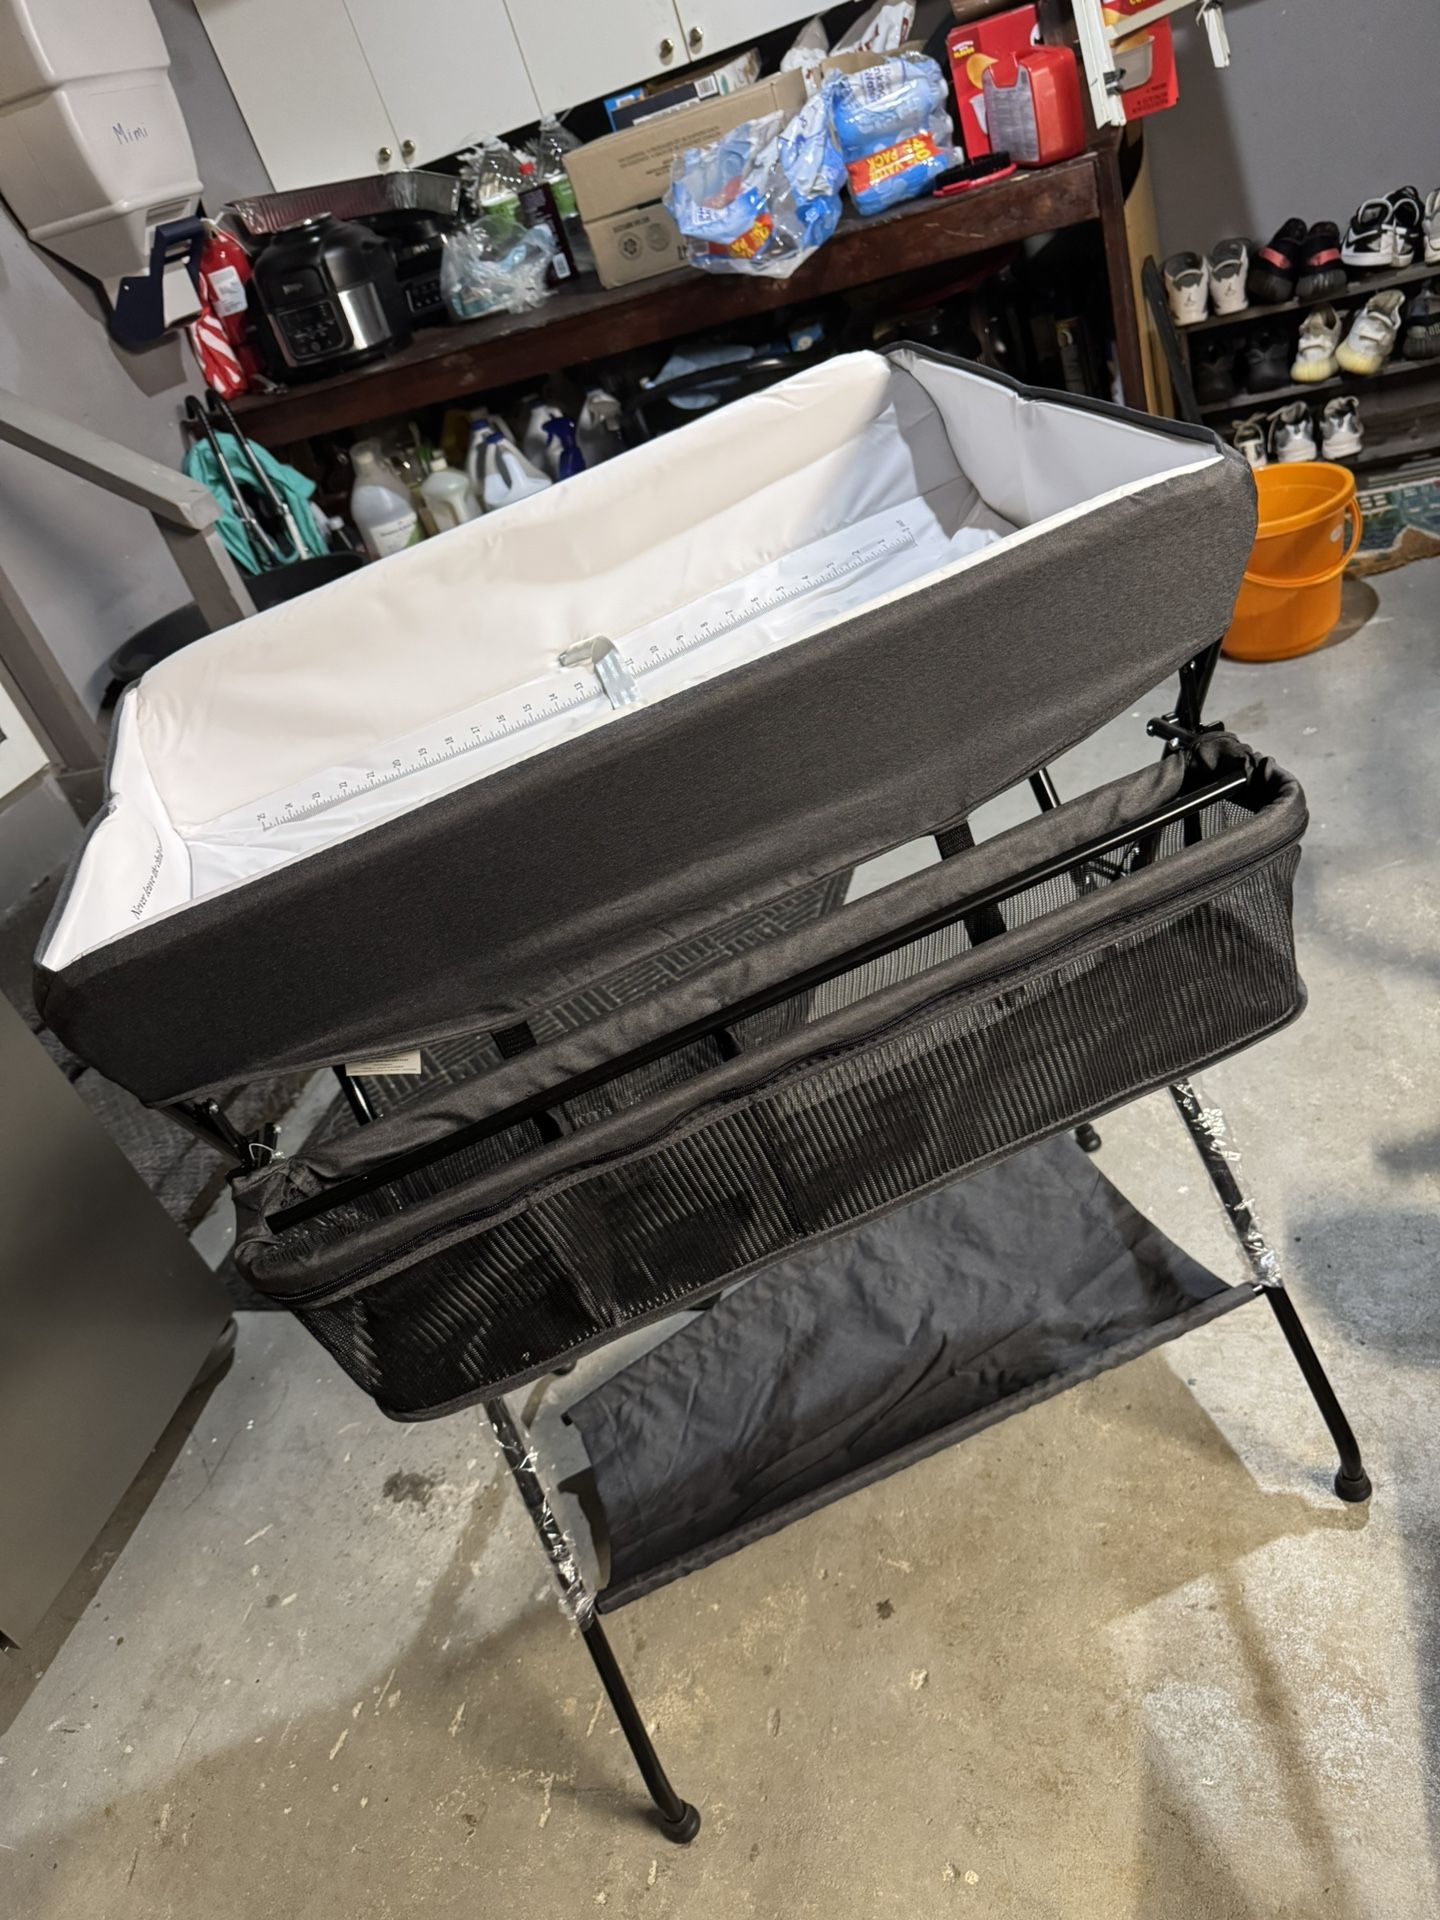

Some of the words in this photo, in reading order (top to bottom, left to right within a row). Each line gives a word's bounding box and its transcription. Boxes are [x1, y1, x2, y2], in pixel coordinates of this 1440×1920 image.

[112, 122, 148, 145] Mimi
[867, 148, 899, 169] PACK
[649, 645, 659, 654] 10
[624, 658, 634, 666] 11
[574, 682, 584, 691] 13
[522, 703, 532, 712] 15
[471, 726, 480, 734] 17
